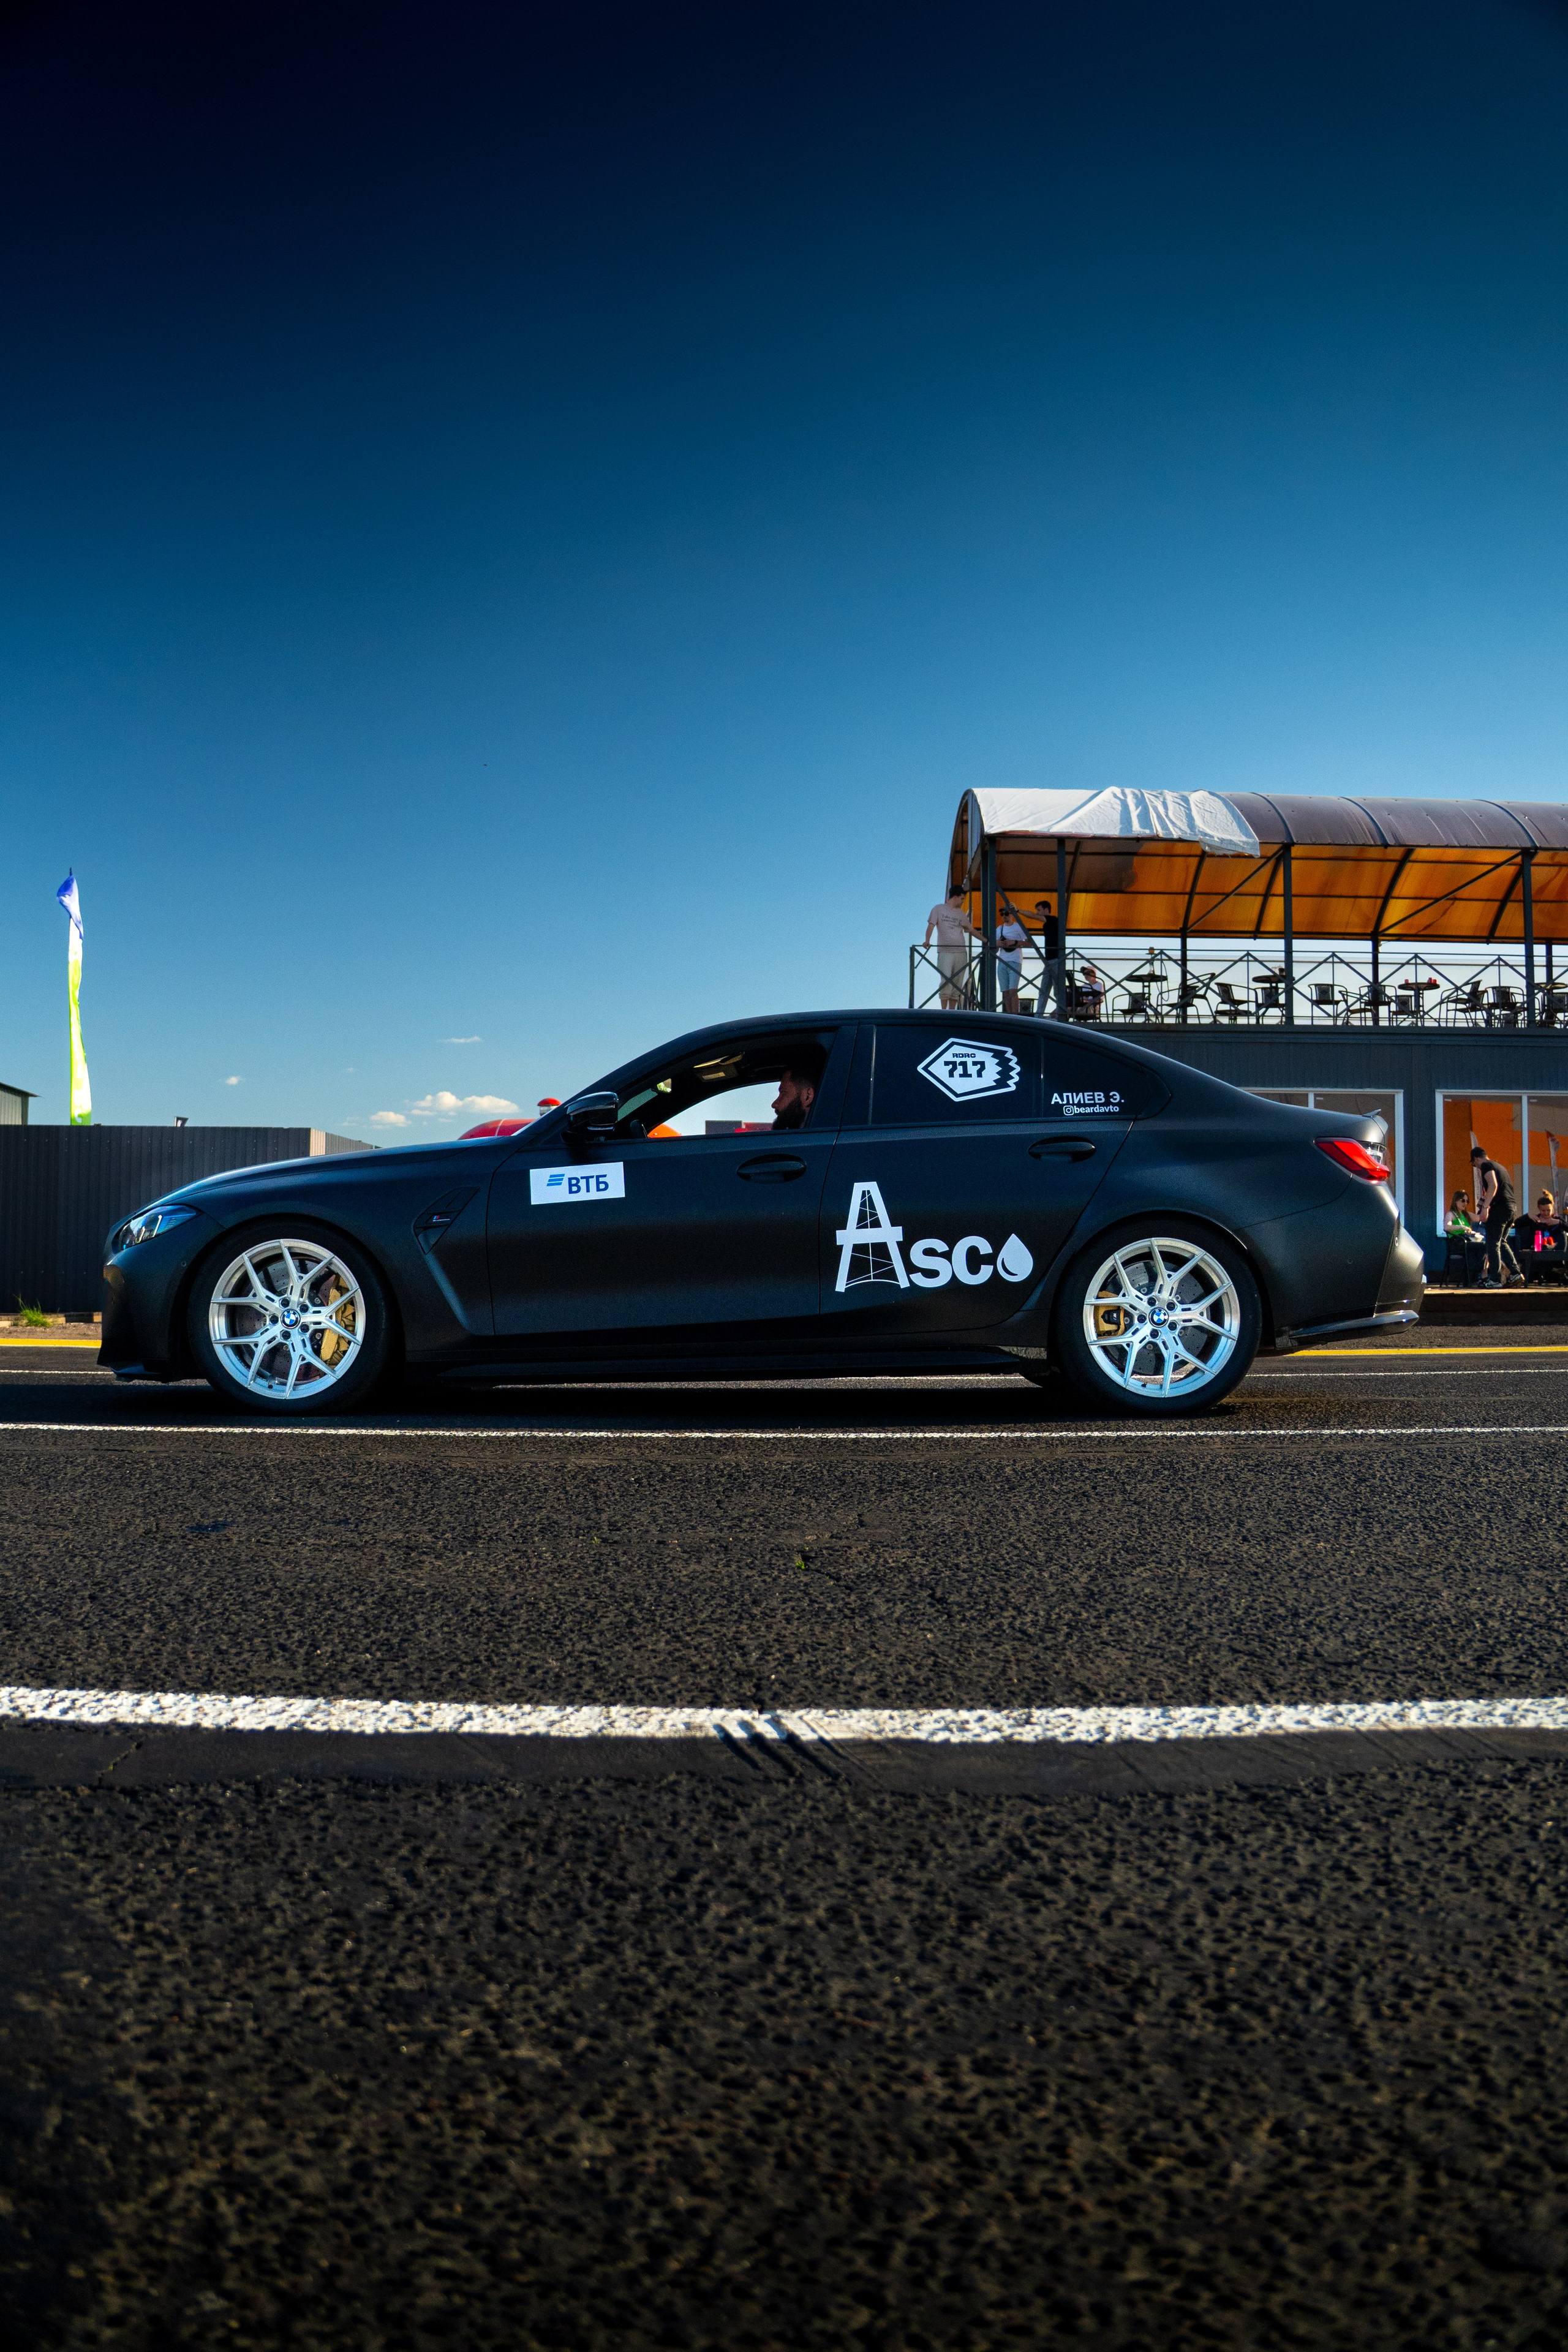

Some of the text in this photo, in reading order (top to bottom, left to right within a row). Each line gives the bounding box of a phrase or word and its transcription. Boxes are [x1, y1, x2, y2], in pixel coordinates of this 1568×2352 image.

[943, 1060, 986, 1078] 717
[1050, 1091, 1125, 1104] АЛИЕВ Э.
[568, 1174, 609, 1194] ВТБ
